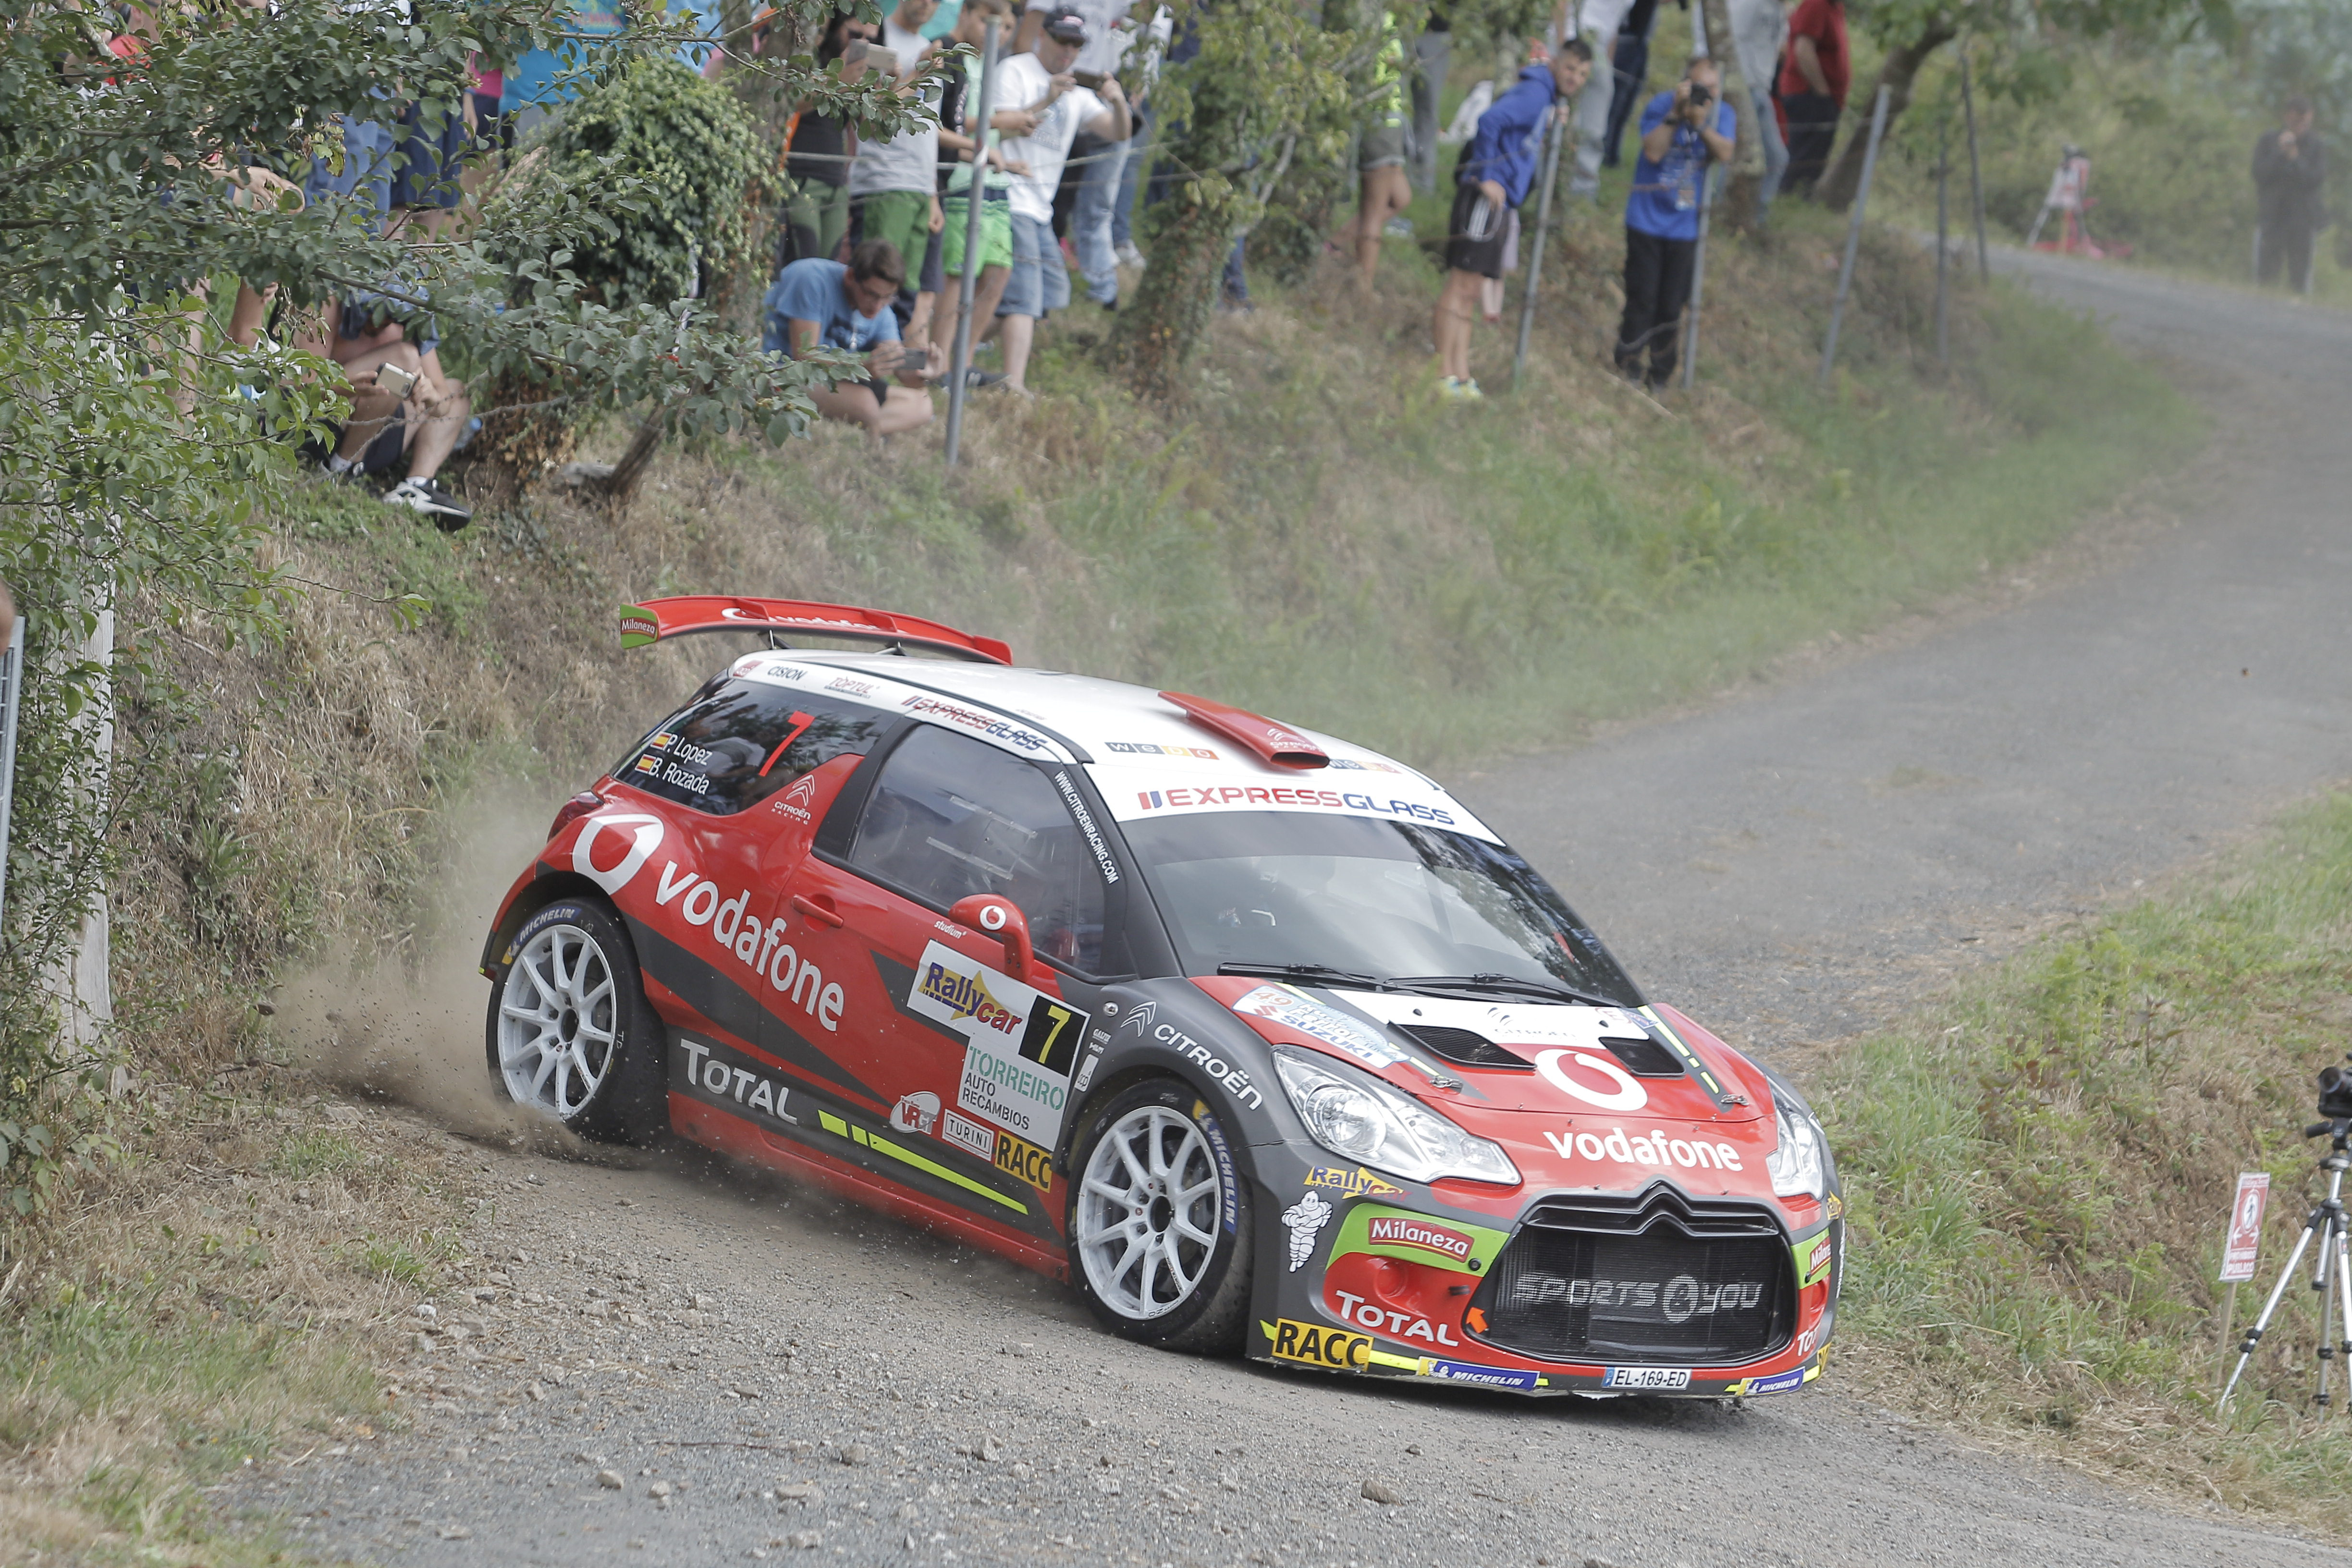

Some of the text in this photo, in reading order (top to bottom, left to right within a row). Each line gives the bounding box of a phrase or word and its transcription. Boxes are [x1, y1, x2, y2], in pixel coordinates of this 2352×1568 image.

[622, 618, 656, 633] Milaneza
[768, 665, 808, 681] CISION
[759, 710, 816, 777] 7
[913, 698, 1048, 751] EXPRESSGLASS
[662, 734, 713, 766] P. Lopez
[648, 757, 711, 795] B. Rozada
[1166, 787, 1455, 825] EXPRESSGLASS
[1054, 771, 1119, 884] WWW.CITROENRACING.COM
[519, 908, 576, 943] MICHELIN
[934, 920, 962, 939] studium
[655, 860, 845, 1031] vodafone
[1253, 991, 1295, 1007] 49
[1038, 1004, 1071, 1064] 7
[1281, 1015, 1374, 1058] SUZUKI
[680, 1038, 797, 1126] TOTAL
[964, 1072, 996, 1096] AUTO
[969, 1045, 1065, 1111] TORREIRO
[962, 1087, 1030, 1130] RECAMBIOS
[949, 1119, 988, 1148] TURINI
[1542, 1127, 1743, 1171] vodafone
[997, 1134, 1052, 1189] RACC
[1208, 1128, 1236, 1225] MICHELIN
[1371, 1220, 1469, 1256] Milaneza
[1513, 1273, 1660, 1308] SPORTS
[1335, 1290, 1459, 1347] TOTAL
[1276, 1323, 1369, 1368] RACC
[1451, 1371, 1525, 1386] MICHELIN
[1614, 1370, 1688, 1387] EL-169-ED
[1758, 1377, 1800, 1393] MICHELIN
